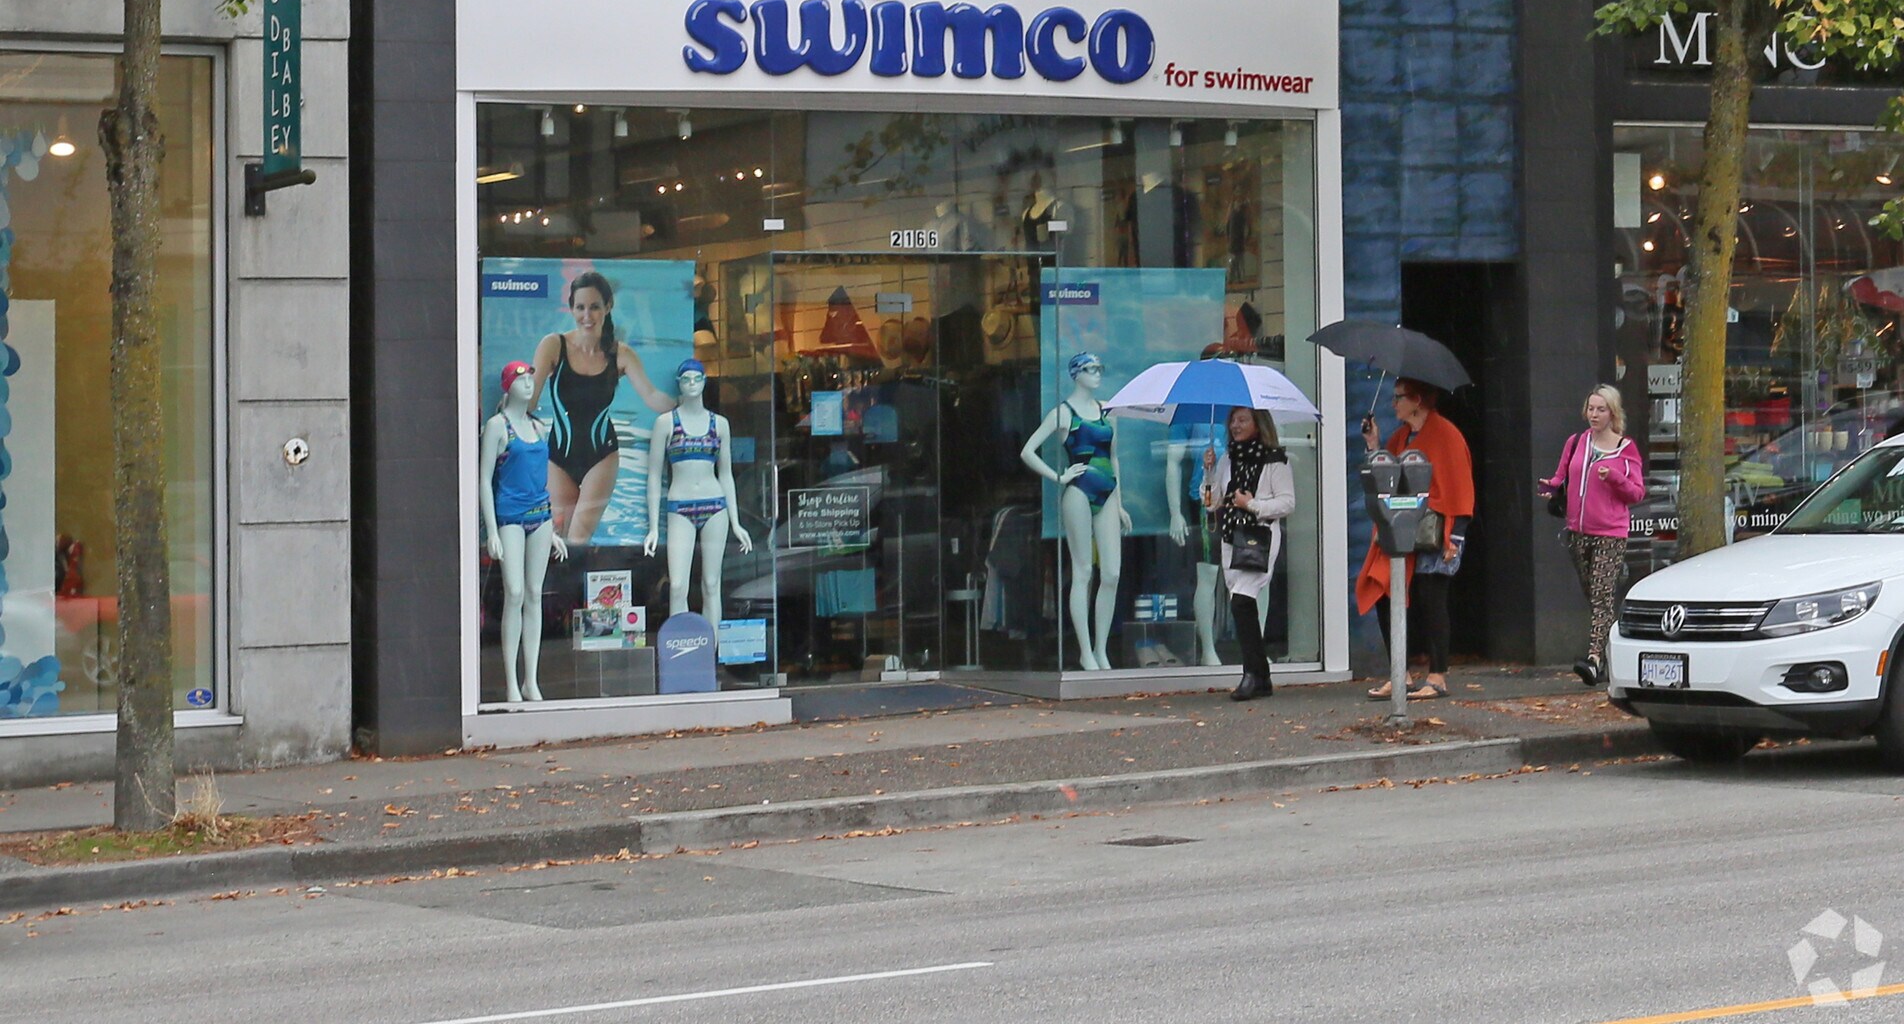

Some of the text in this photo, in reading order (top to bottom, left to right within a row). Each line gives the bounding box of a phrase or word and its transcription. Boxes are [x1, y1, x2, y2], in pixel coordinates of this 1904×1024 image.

[1164, 62, 1314, 94] for swimwear
[282, 27, 293, 151] BABY
[891, 230, 938, 247] 2166
[490, 278, 540, 292] swimco
[1048, 287, 1092, 299] swimco
[798, 492, 859, 508] Shop Online
[798, 507, 860, 518] Free Shipping
[1628, 514, 1654, 536] ing
[665, 636, 709, 650] speedo
